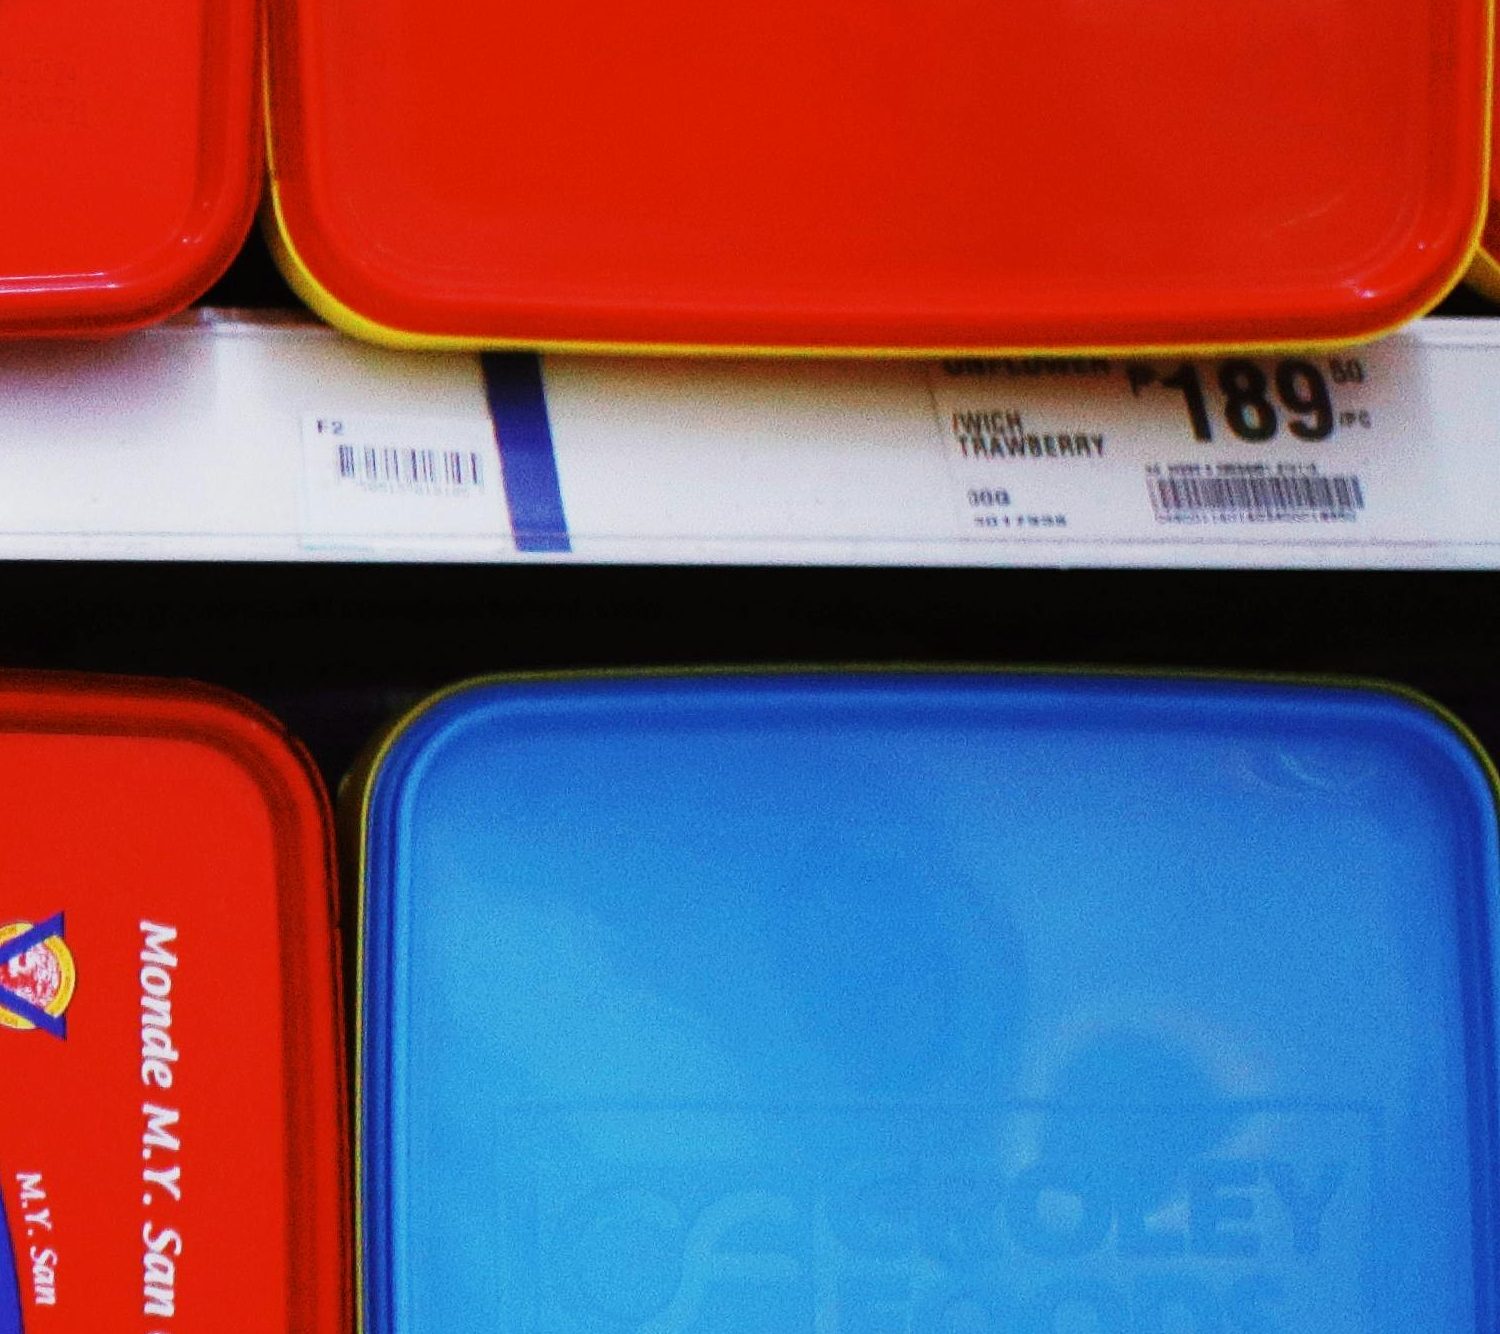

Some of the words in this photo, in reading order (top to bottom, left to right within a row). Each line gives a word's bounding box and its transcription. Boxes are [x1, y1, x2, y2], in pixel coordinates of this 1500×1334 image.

[140, 921, 179, 1088] Monde
[137, 1100, 181, 1202] M.Y.
[143, 1222, 182, 1317] San
